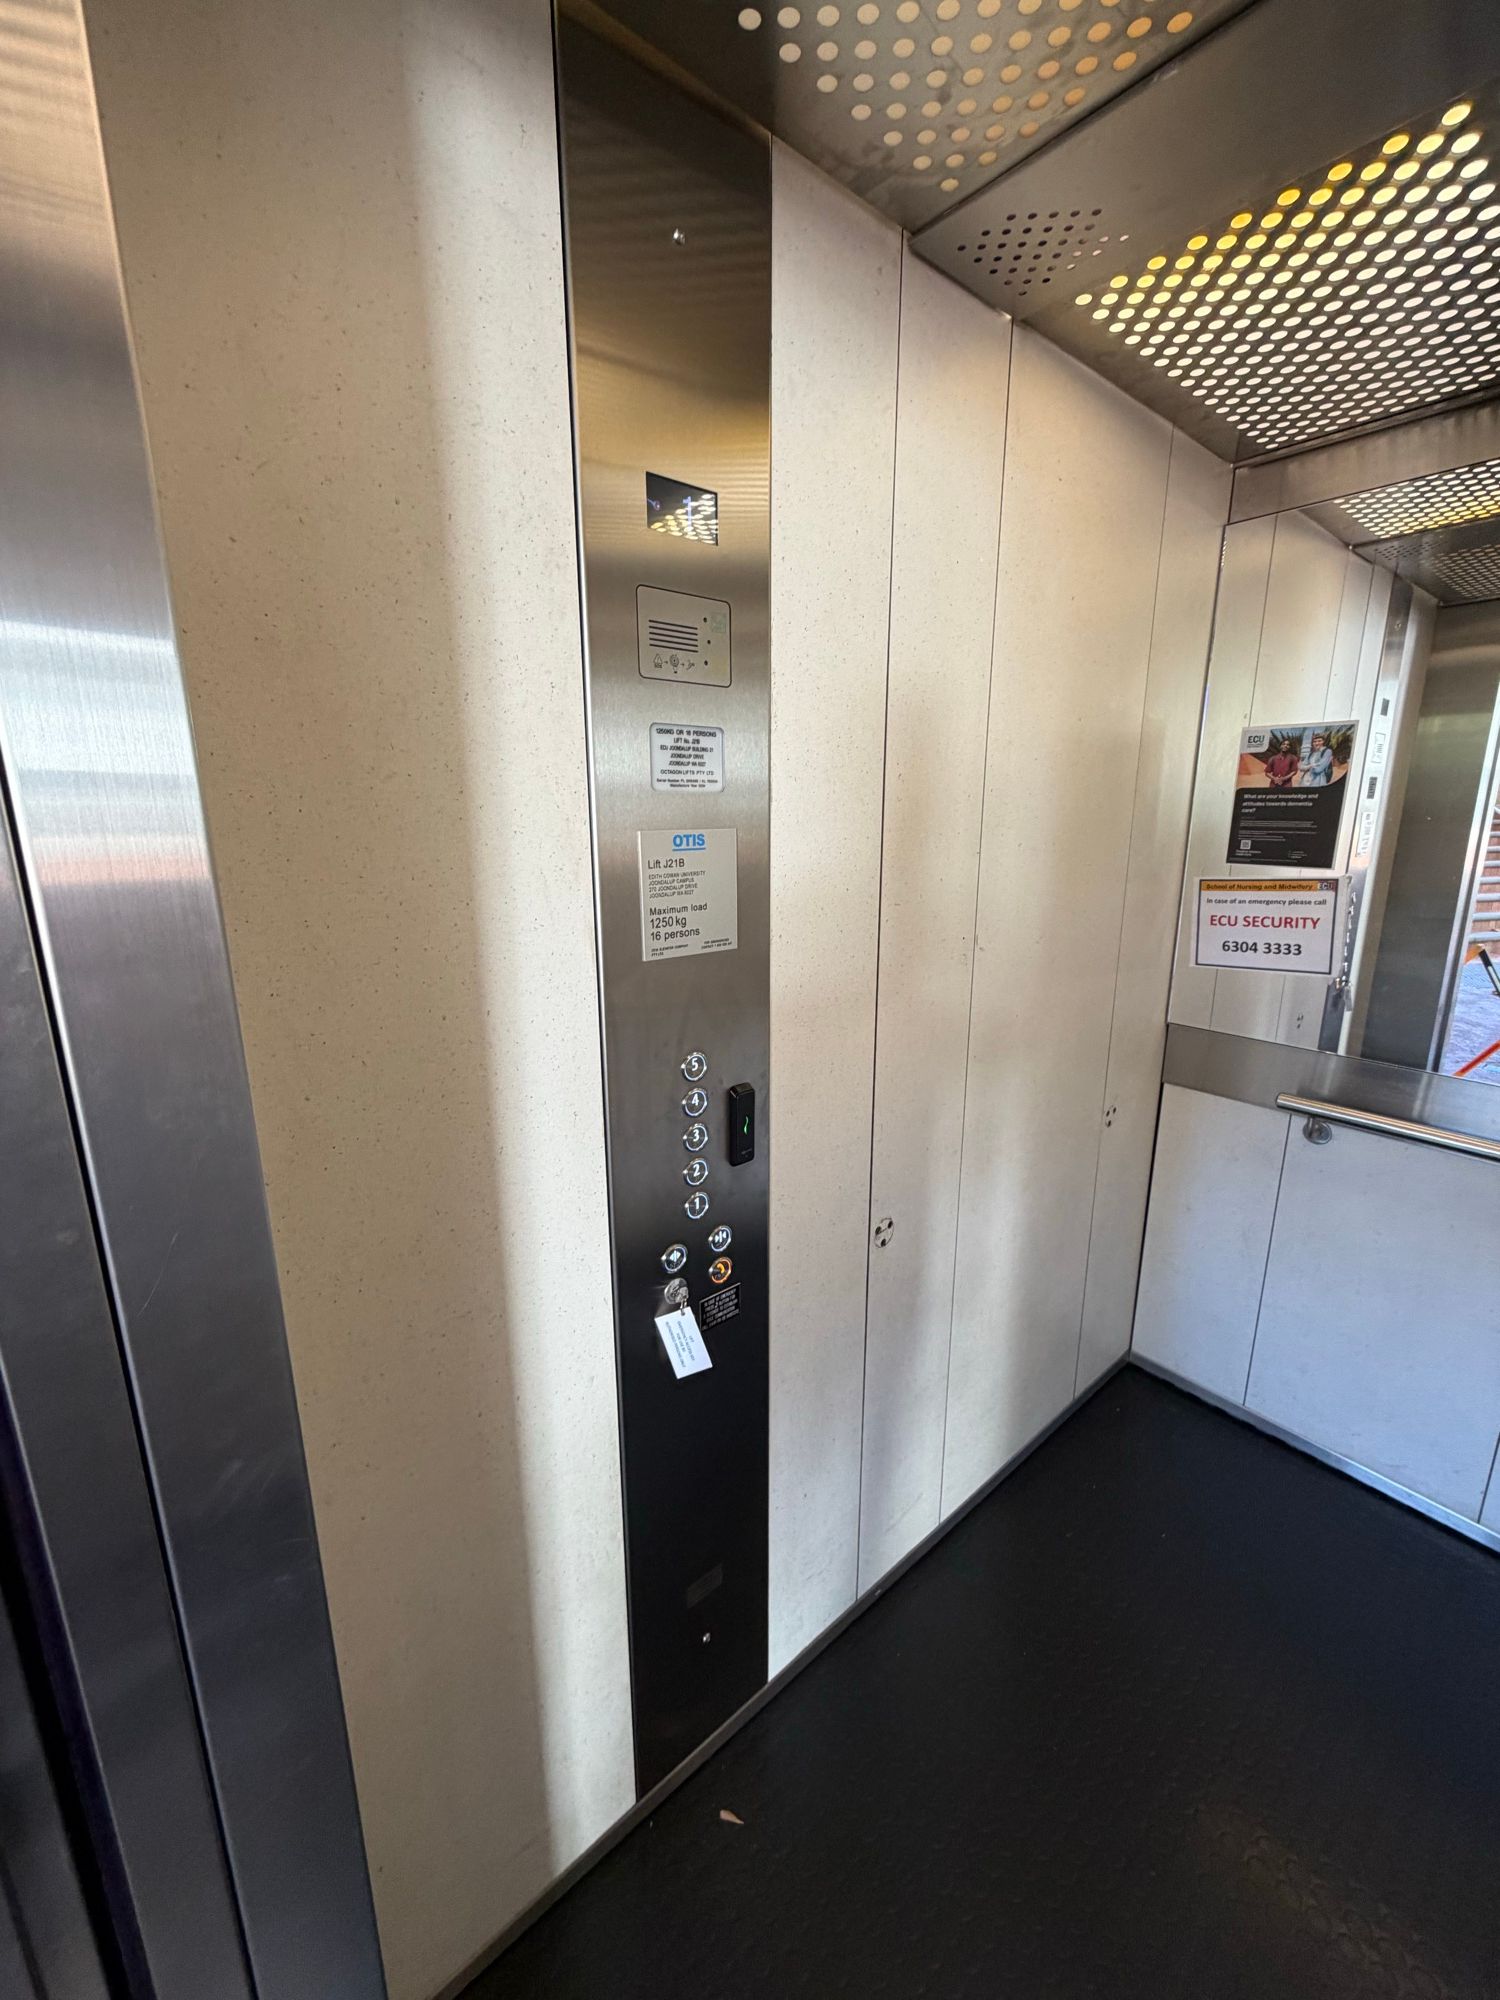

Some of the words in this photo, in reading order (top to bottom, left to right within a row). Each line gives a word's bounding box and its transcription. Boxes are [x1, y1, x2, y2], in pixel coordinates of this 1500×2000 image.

[1248, 735, 1265, 744] ECU
[672, 834, 705, 847] OTIS
[648, 859, 661, 870] Lift
[663, 858, 685, 868] J21B
[650, 905, 688, 916] Maximum
[691, 902, 708, 912] load
[650, 917, 674, 929] 1250
[676, 916, 686, 928] kg
[1210, 915, 1238, 927] ECU
[1242, 916, 1320, 929] SECURITY
[651, 931, 661, 941] 16
[664, 928, 700, 942] persons
[1222, 940, 1258, 953] 6304
[1263, 942, 1302, 956] 3333
[691, 1058, 698, 1071] 5
[692, 1094, 699, 1106] 4
[693, 1130, 700, 1142] 3
[693, 1164, 700, 1176] 2
[695, 1198, 700, 1209] 1
